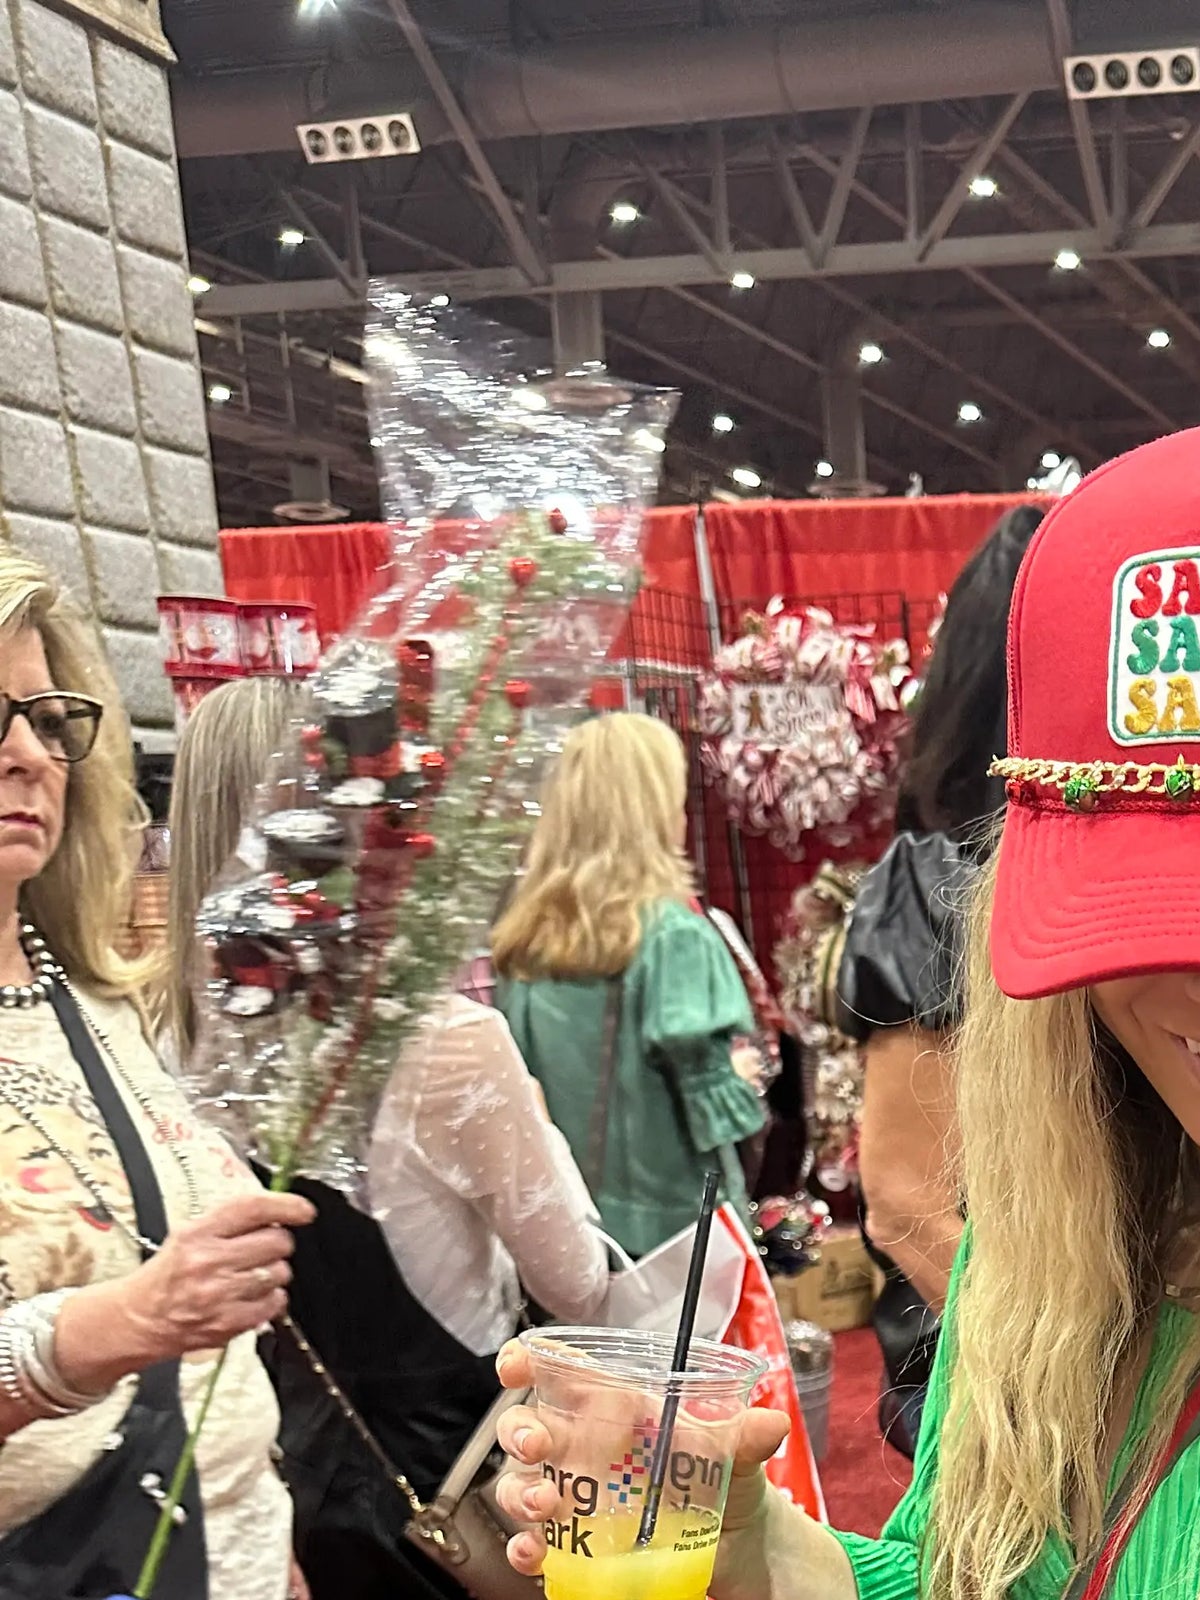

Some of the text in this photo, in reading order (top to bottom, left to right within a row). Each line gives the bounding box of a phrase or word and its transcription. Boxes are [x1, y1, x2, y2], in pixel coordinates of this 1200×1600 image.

[545, 1517, 594, 1558] ark
[681, 1529, 699, 1538] Fans
[674, 1542, 692, 1552] Fans
